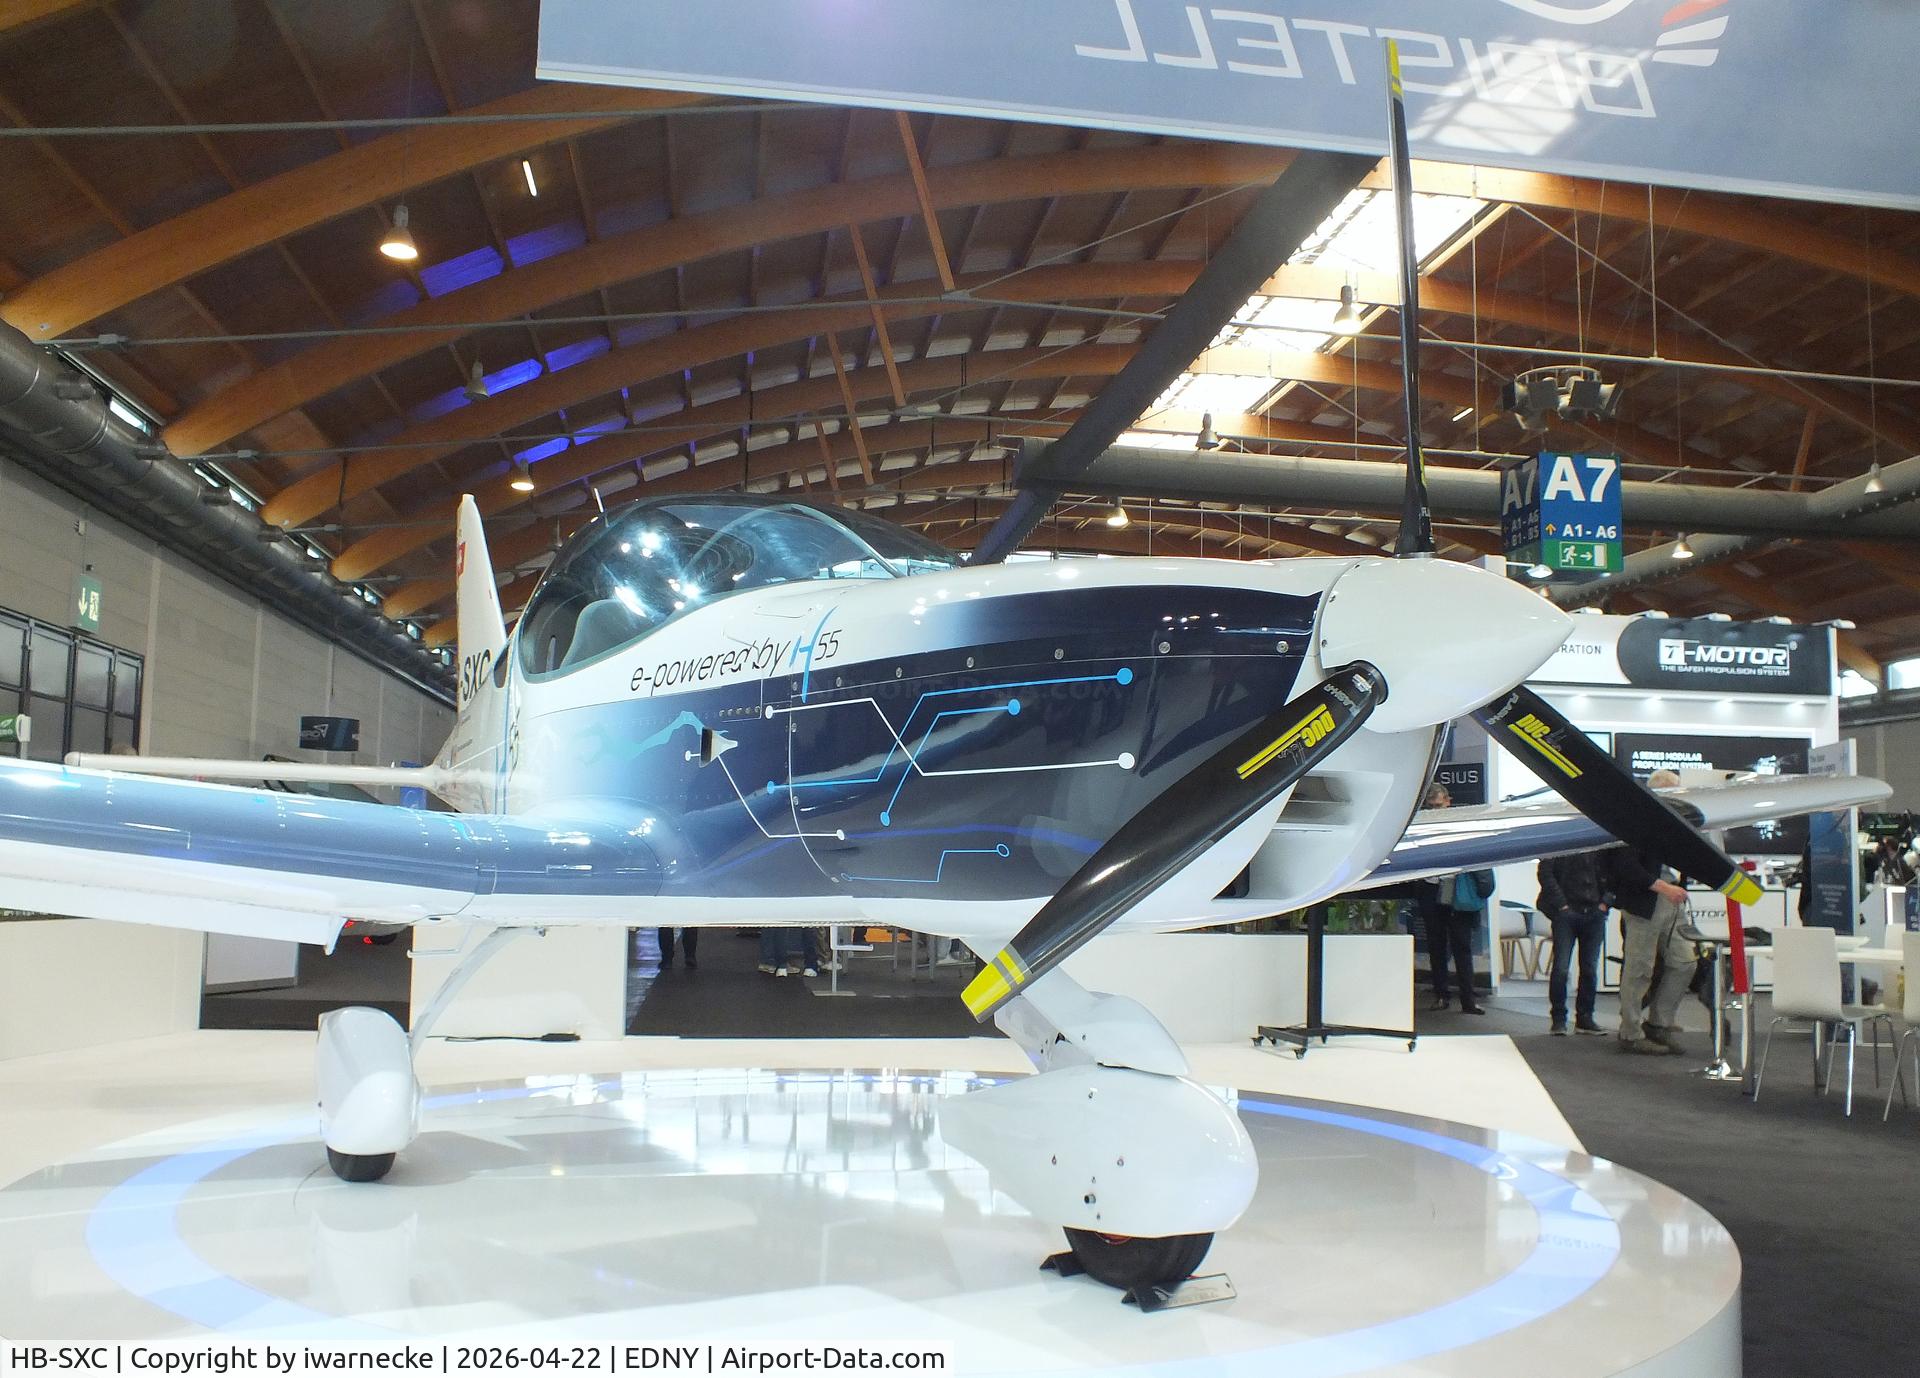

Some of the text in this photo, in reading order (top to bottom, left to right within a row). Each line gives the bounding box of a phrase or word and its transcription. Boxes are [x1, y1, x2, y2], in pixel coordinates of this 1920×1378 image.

[1502, 458, 1538, 516] A7
[1544, 456, 1617, 503] A7
[1561, 644, 1602, 655] RATION
[1659, 638, 1788, 667] T-MOTOR
[630, 640, 757, 697] e-powered
[752, 637, 791, 677] by
[1660, 665, 1790, 677] THE SAFER PROPULSION SYSTEM
[1300, 710, 1336, 748] DUC
[1515, 713, 1551, 740] DUC
[1632, 751, 1640, 760] A
[1665, 752, 1703, 762] MODULAR
[1632, 760, 1680, 770] PROPULSION
[1687, 910, 1726, 919] OTOR
